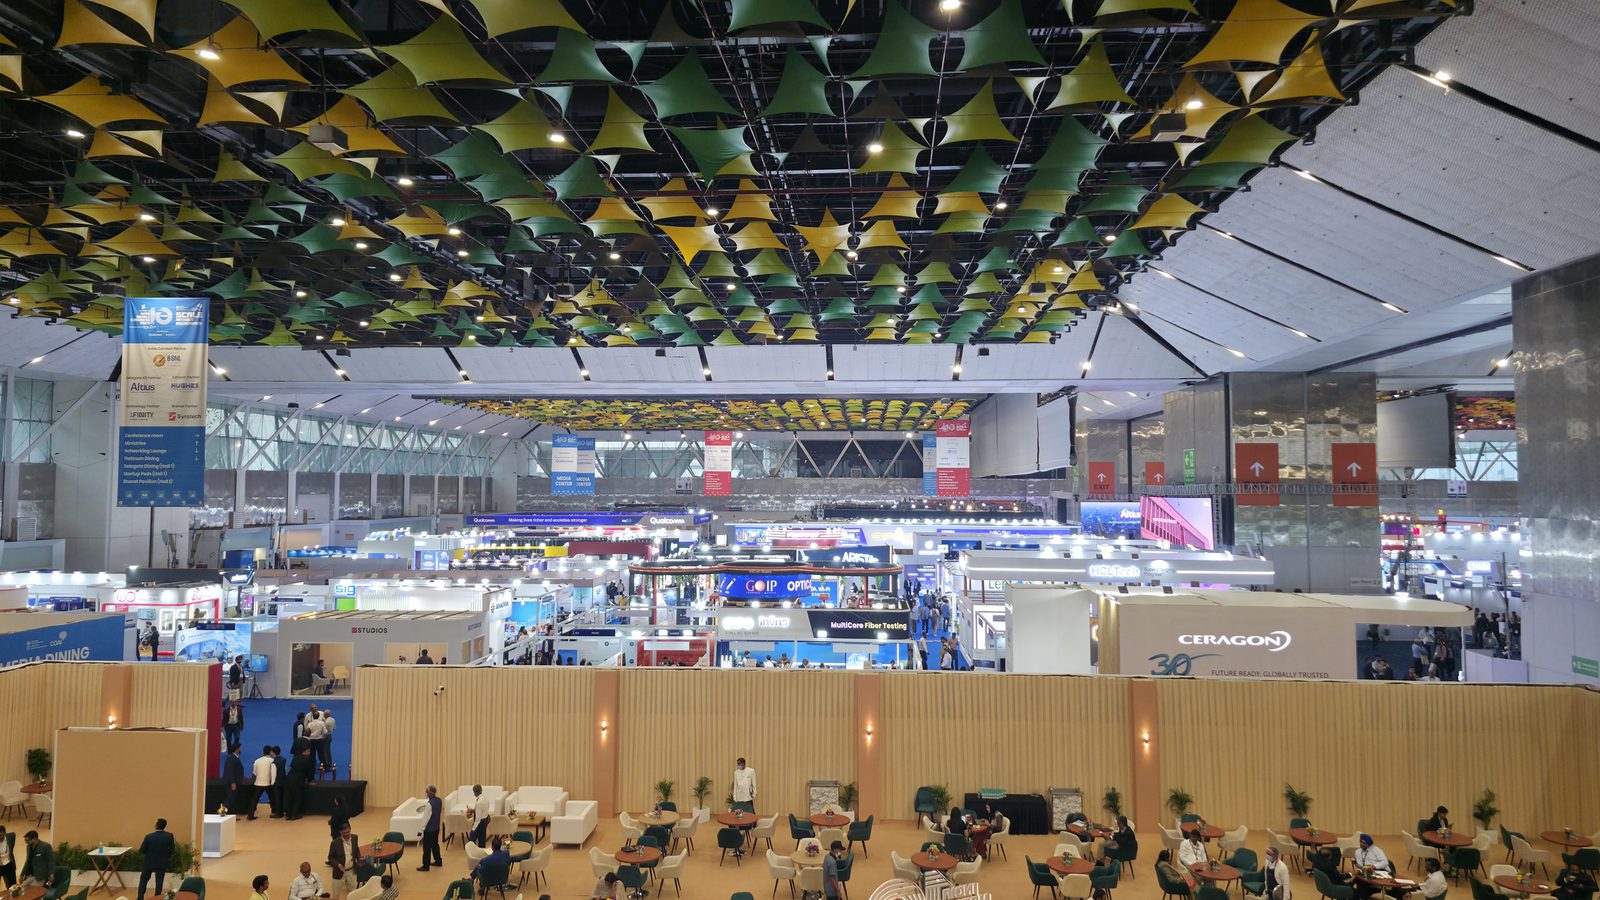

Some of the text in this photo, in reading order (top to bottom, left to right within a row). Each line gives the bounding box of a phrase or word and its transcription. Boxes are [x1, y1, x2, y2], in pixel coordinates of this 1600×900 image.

[131, 383, 155, 391] Altius
[1090, 565, 1140, 577] HCLTech
[883, 622, 907, 630] Testing
[1178, 632, 1291, 650] CERAGON
[46, 646, 90, 661] DINING
[1148, 653, 1192, 676] 30
